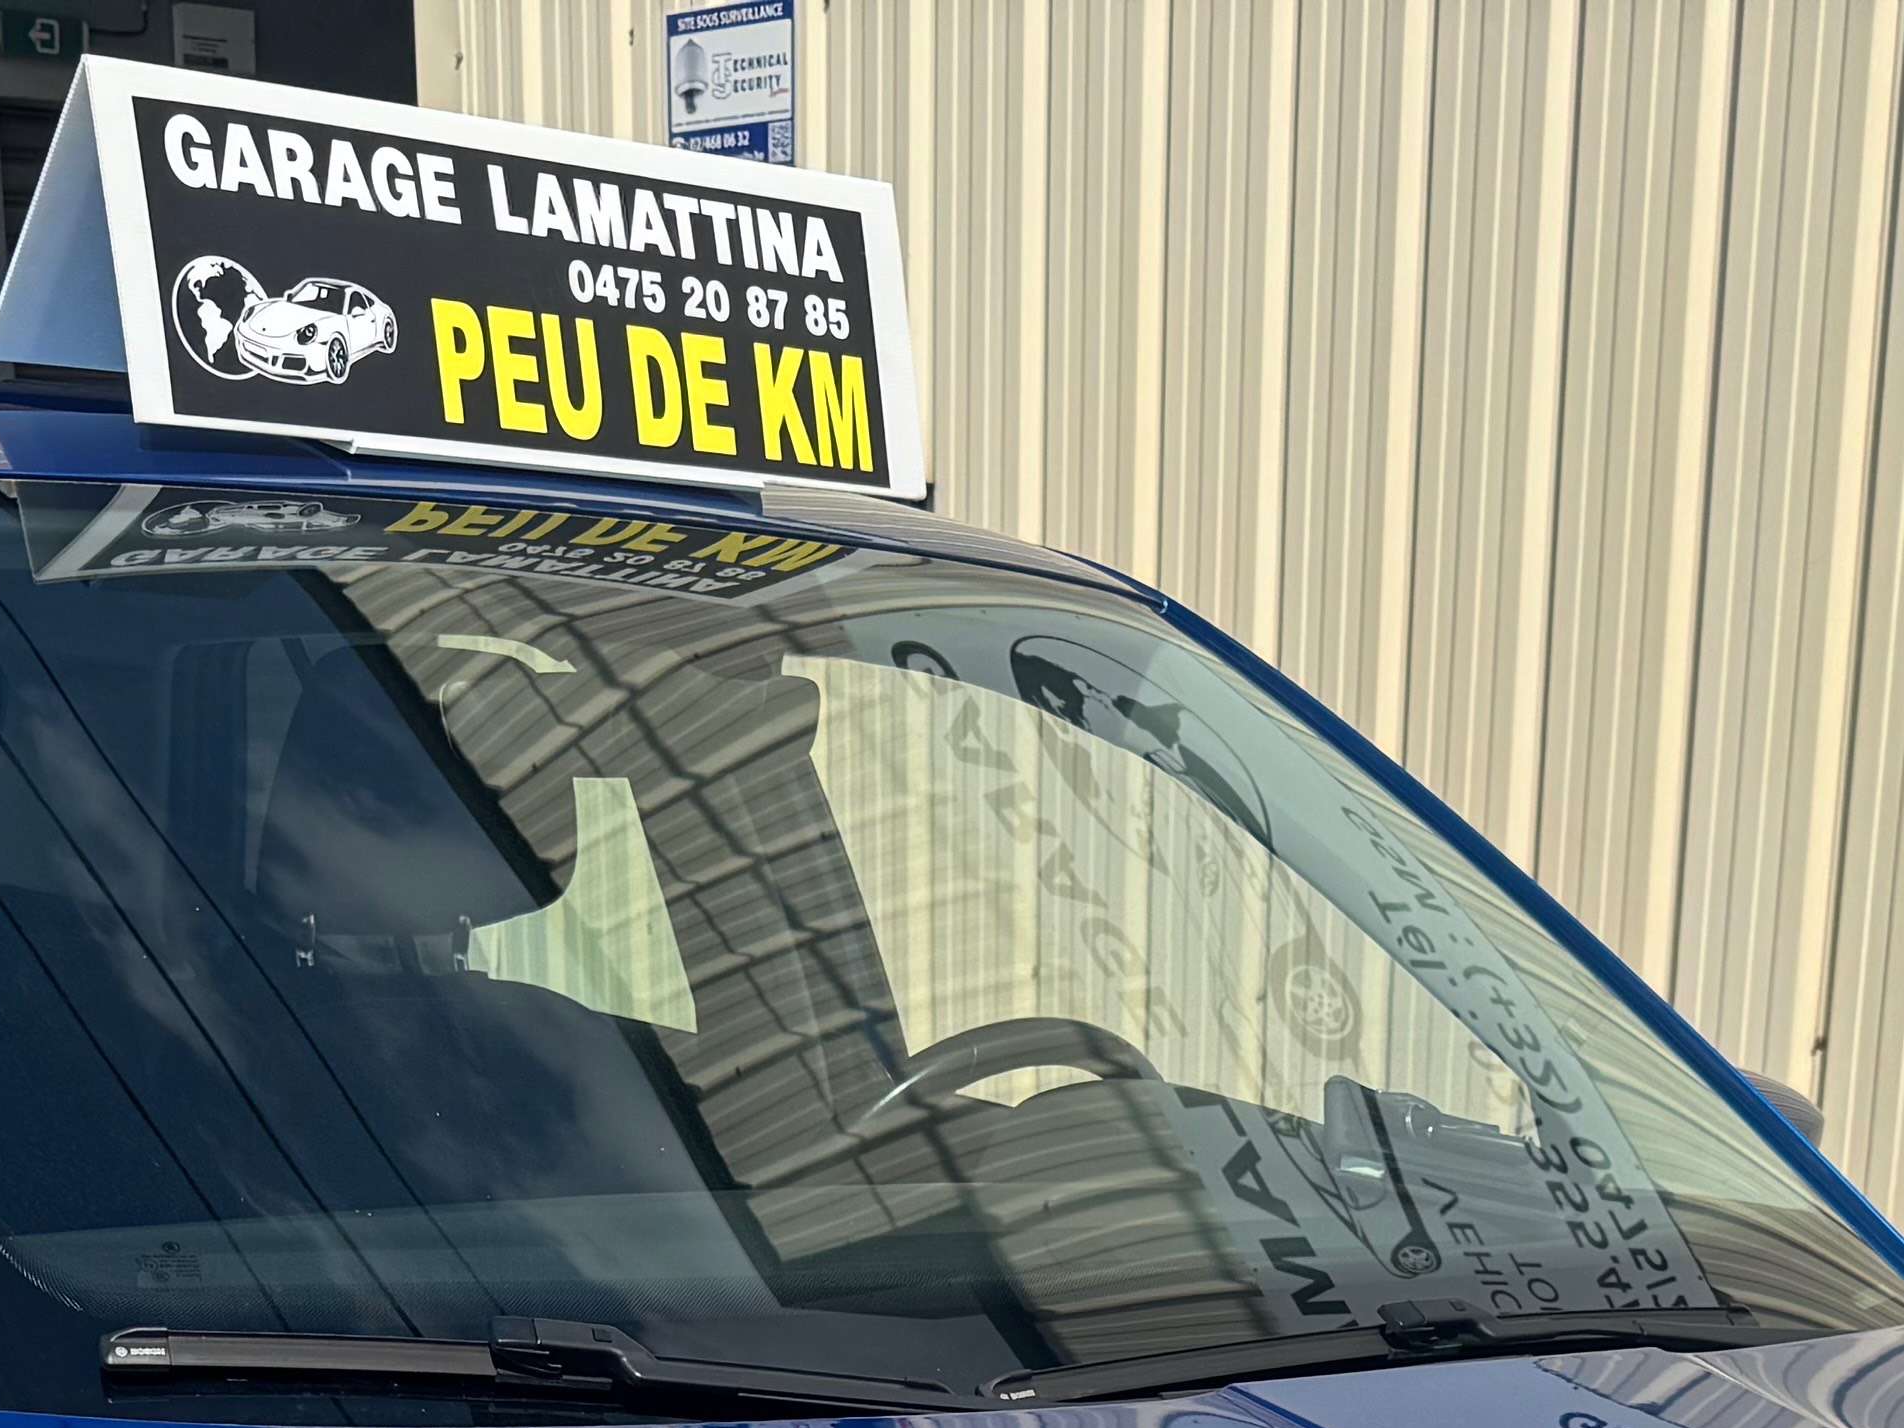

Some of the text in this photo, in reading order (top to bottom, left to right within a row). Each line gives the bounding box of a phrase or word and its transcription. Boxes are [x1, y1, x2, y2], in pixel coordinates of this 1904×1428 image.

[164, 113, 845, 283] GARAGE LAMATTINA
[431, 297, 874, 472] PEU DE KM
[568, 260, 851, 341] 0475 20 87 85
